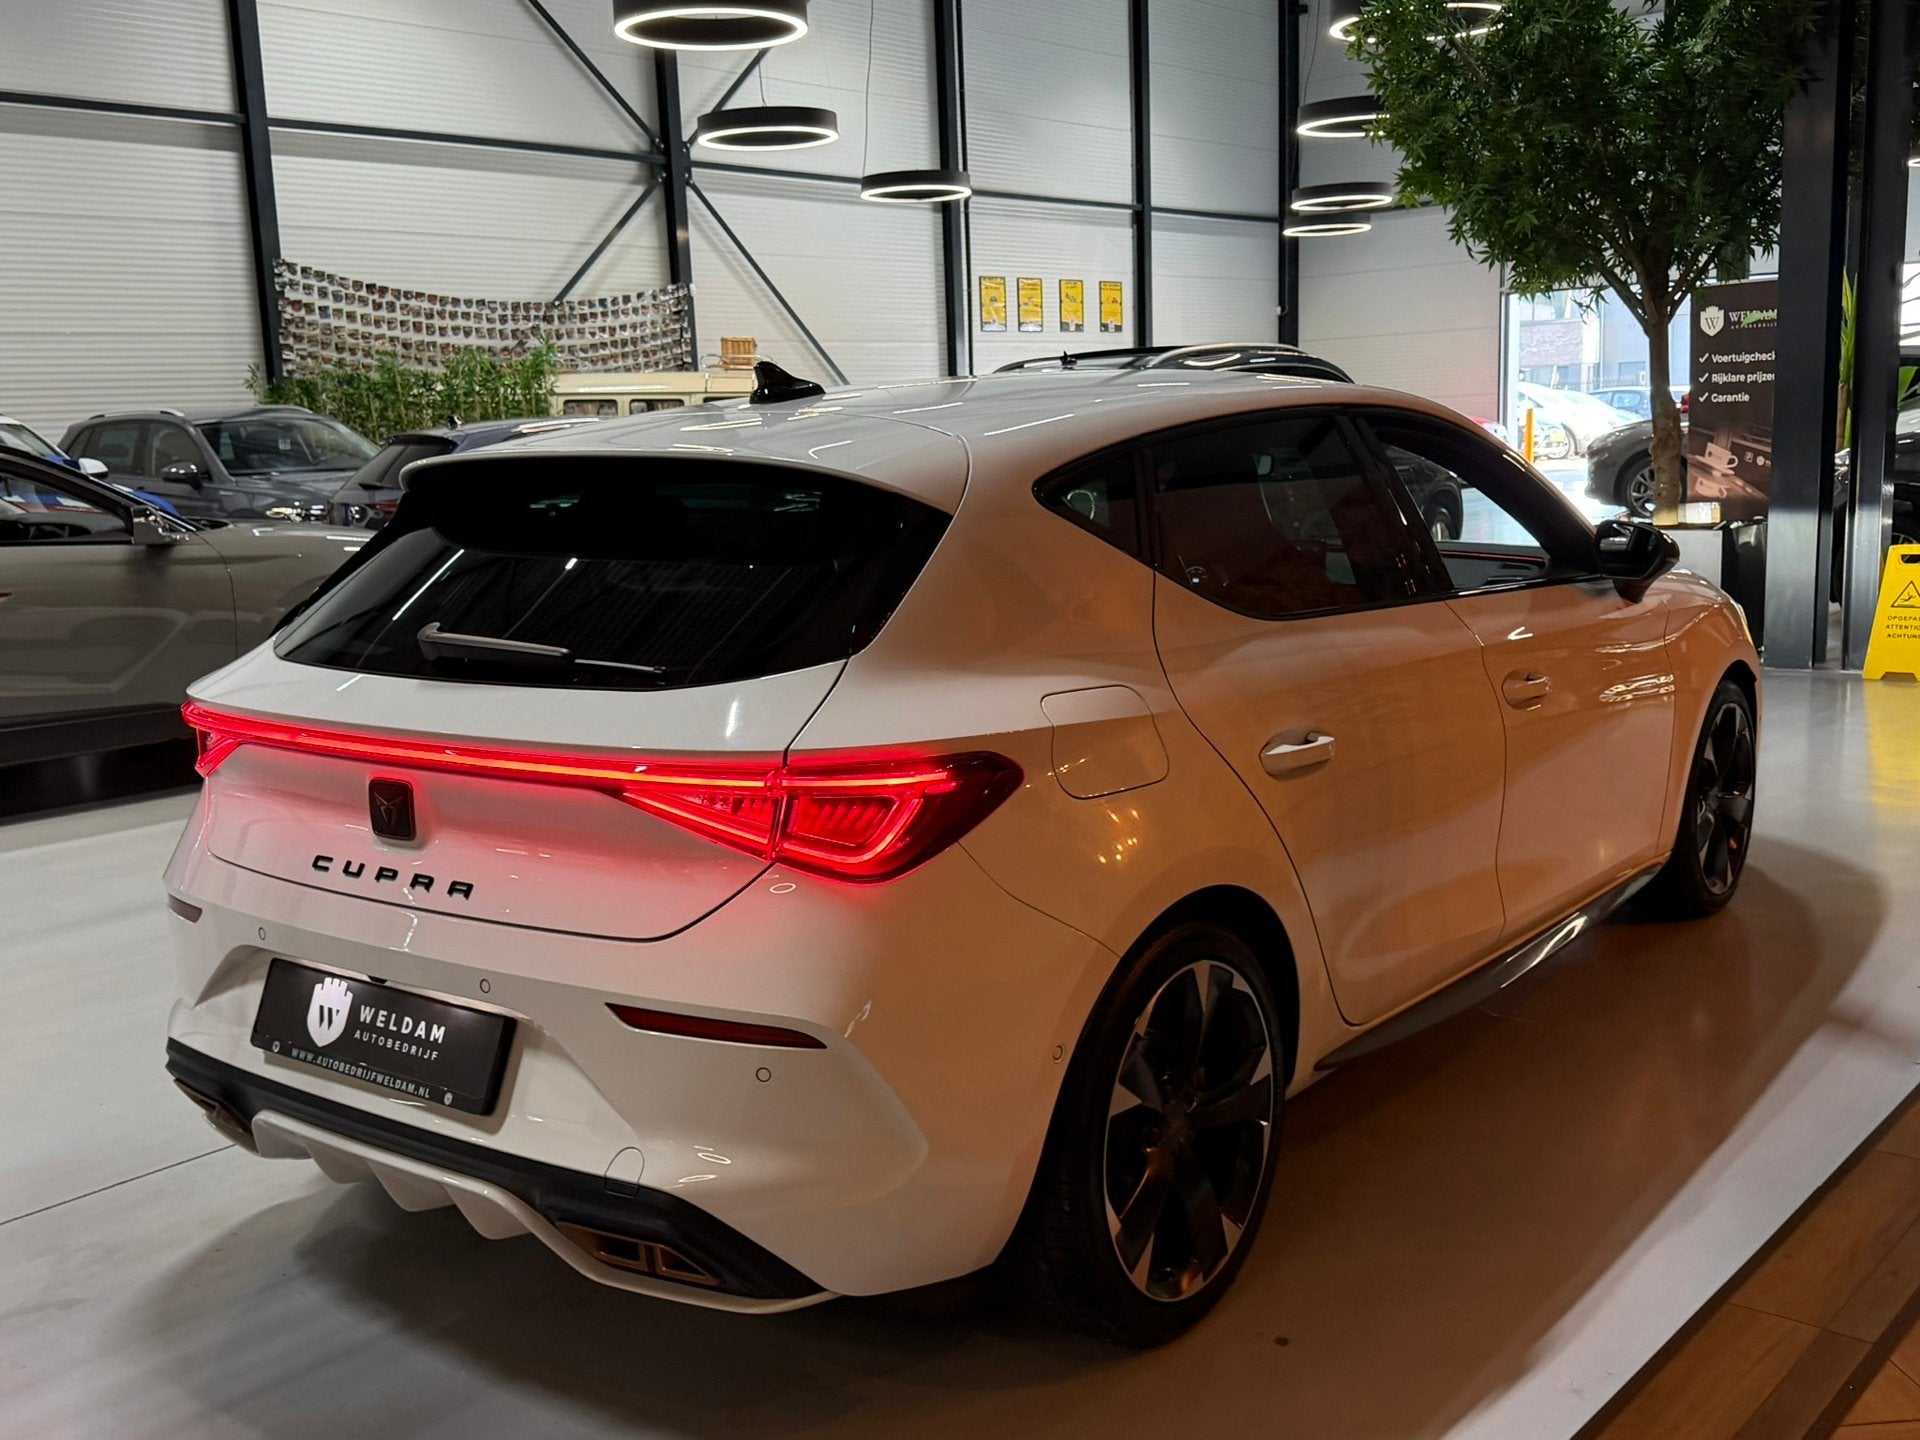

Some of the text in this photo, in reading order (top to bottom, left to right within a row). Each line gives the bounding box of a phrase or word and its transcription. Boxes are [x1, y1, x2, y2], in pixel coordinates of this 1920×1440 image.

[1704, 317, 1720, 331] W
[1711, 372, 1746, 384] Rijklare
[1711, 392, 1750, 403] Garantie
[312, 854, 475, 900] CUPRA
[318, 1004, 340, 1032] W
[359, 1004, 447, 1044] WELDAM
[353, 1029, 440, 1061] AUTOBEDRIJF
[291, 1047, 431, 1099] WWW.AUTOBEDRIJFWELDAM.NL
